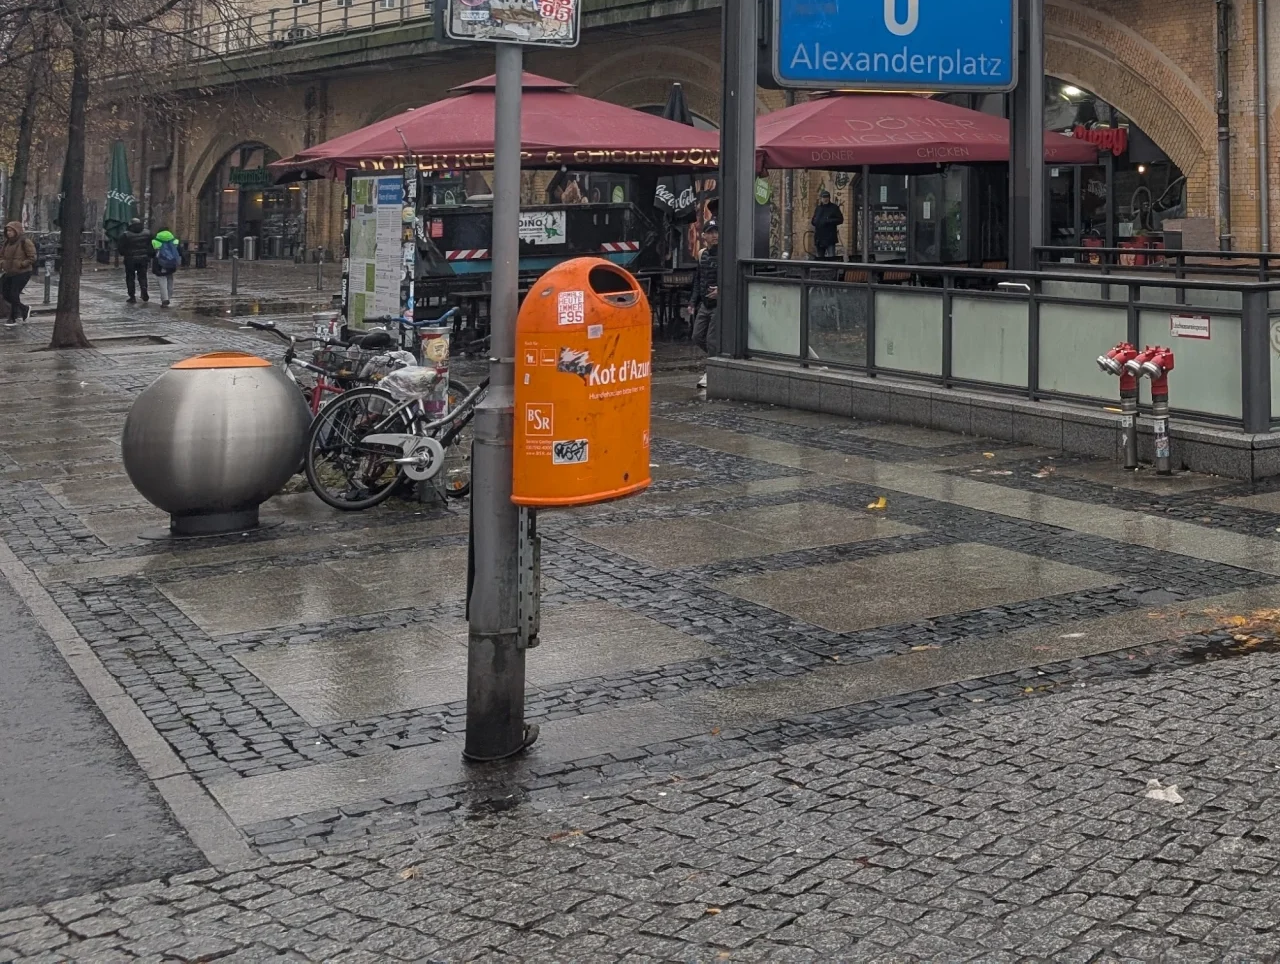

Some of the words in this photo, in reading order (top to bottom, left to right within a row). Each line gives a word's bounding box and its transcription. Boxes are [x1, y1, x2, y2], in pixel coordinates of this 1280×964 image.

[790, 43, 1002, 80] Alexanderplatz
[845, 115, 978, 131] DÖNER
[573, 150, 666, 163] CHICKEN
[811, 148, 854, 161] DÖNER
[917, 147, 969, 157] CHICKEN
[559, 297, 583, 305] HEUTE
[559, 311, 583, 324] F95
[589, 363, 616, 386] Kot
[527, 409, 550, 430] BSR
